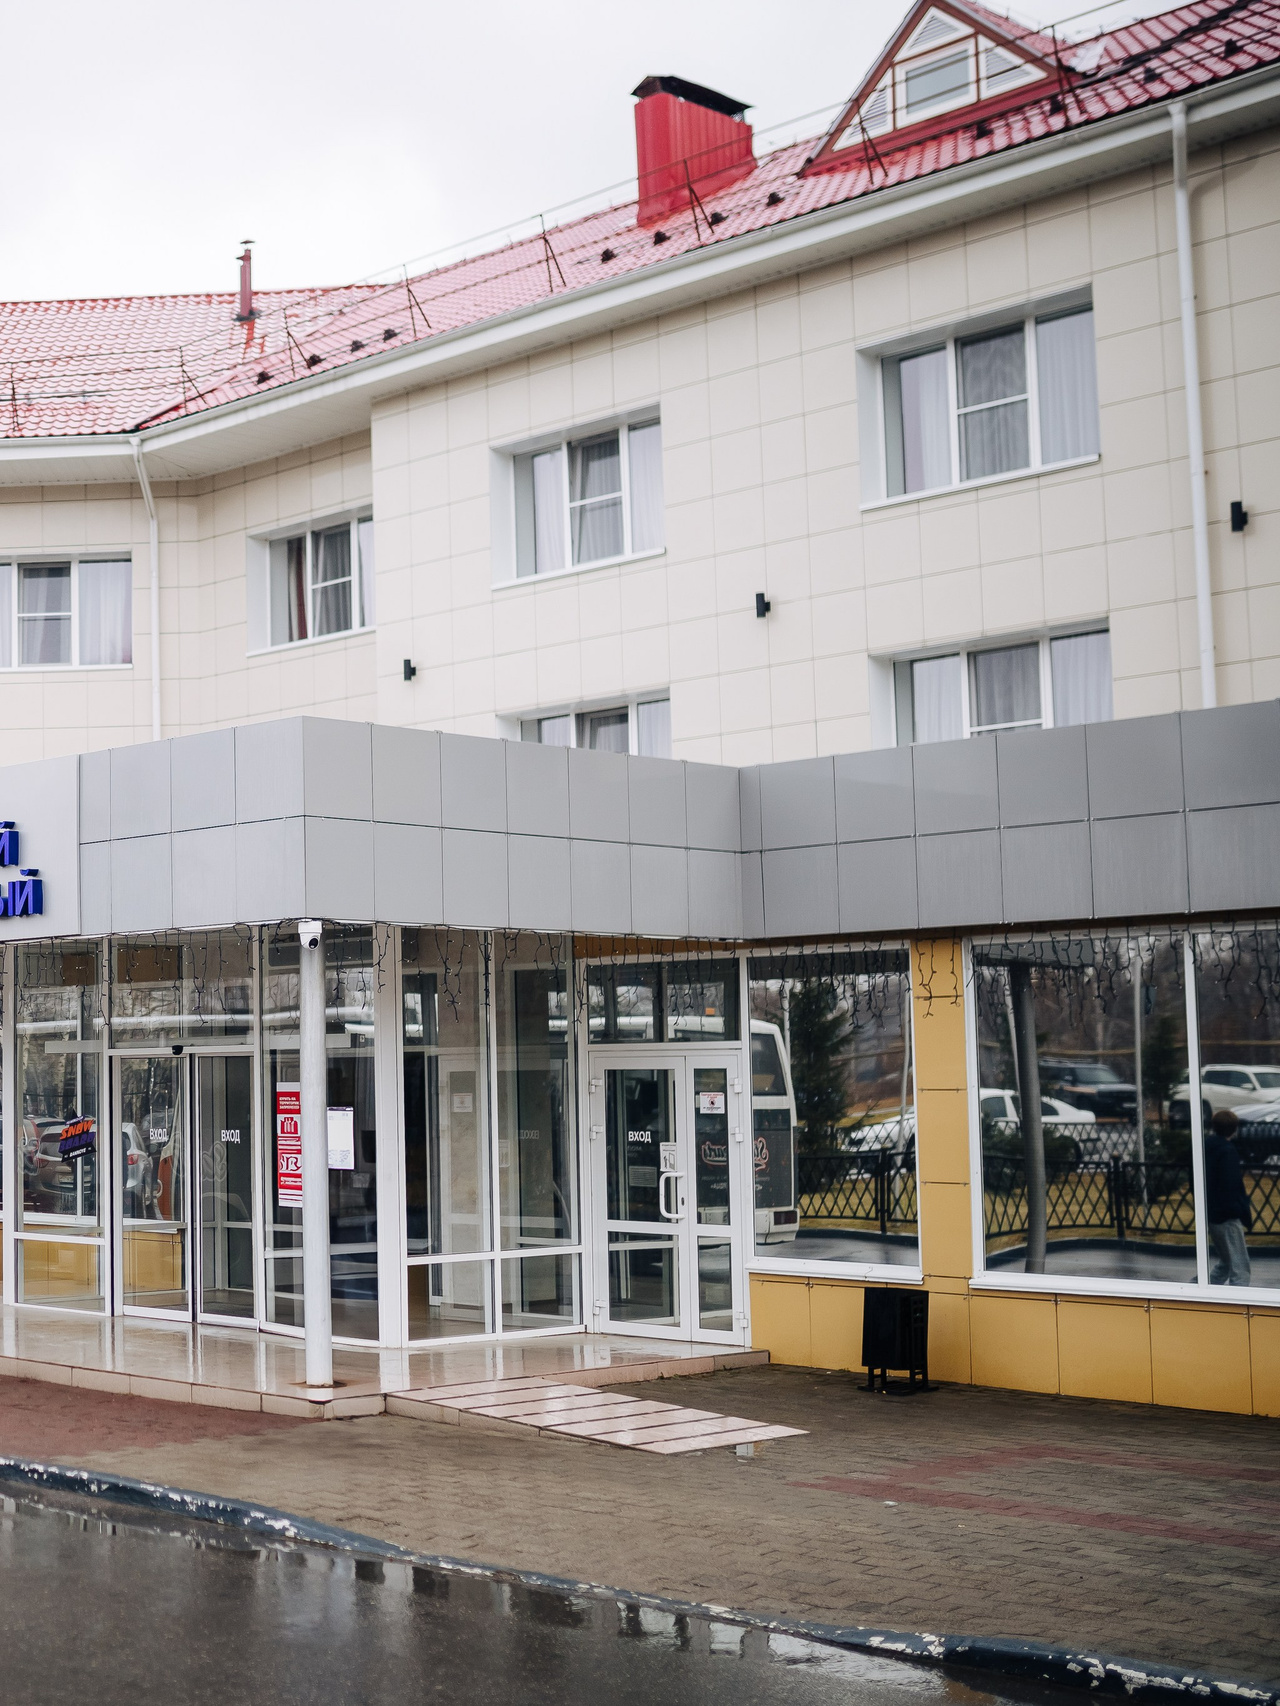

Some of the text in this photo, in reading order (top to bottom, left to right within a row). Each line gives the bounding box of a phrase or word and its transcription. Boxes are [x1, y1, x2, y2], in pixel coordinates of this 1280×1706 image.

[60, 1119, 94, 1140] SNOW
[149, 1128, 169, 1142] ВХОД
[221, 1130, 240, 1144] ВХОД
[628, 1131, 652, 1143] ВХОД
